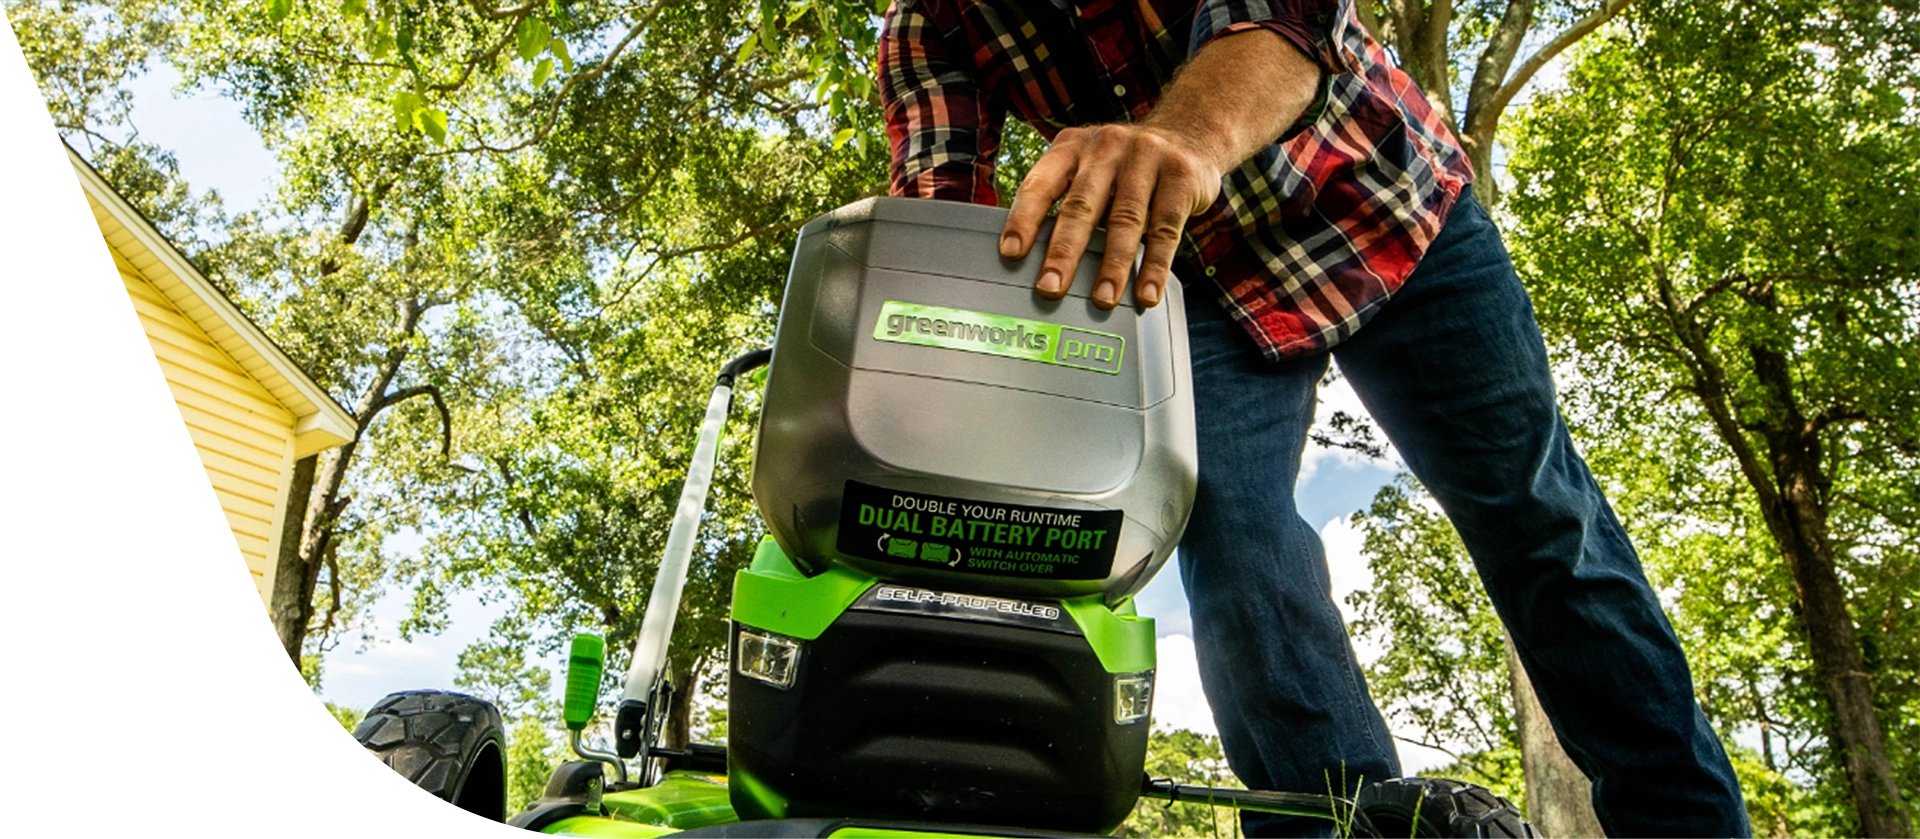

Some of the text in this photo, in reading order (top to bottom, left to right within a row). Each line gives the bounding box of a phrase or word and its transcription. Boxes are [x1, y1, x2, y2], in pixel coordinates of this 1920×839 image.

[887, 312, 1114, 363] greenworks pro
[858, 503, 1107, 550] DUAL BATTERY PORT
[892, 495, 1082, 528] DOUBLE YOUR RUNTIME
[967, 558, 1054, 574] SWITCH OVER
[969, 546, 1080, 564] WITH AUTOMATIC
[876, 586, 1059, 620] SELF-PROPELLED
